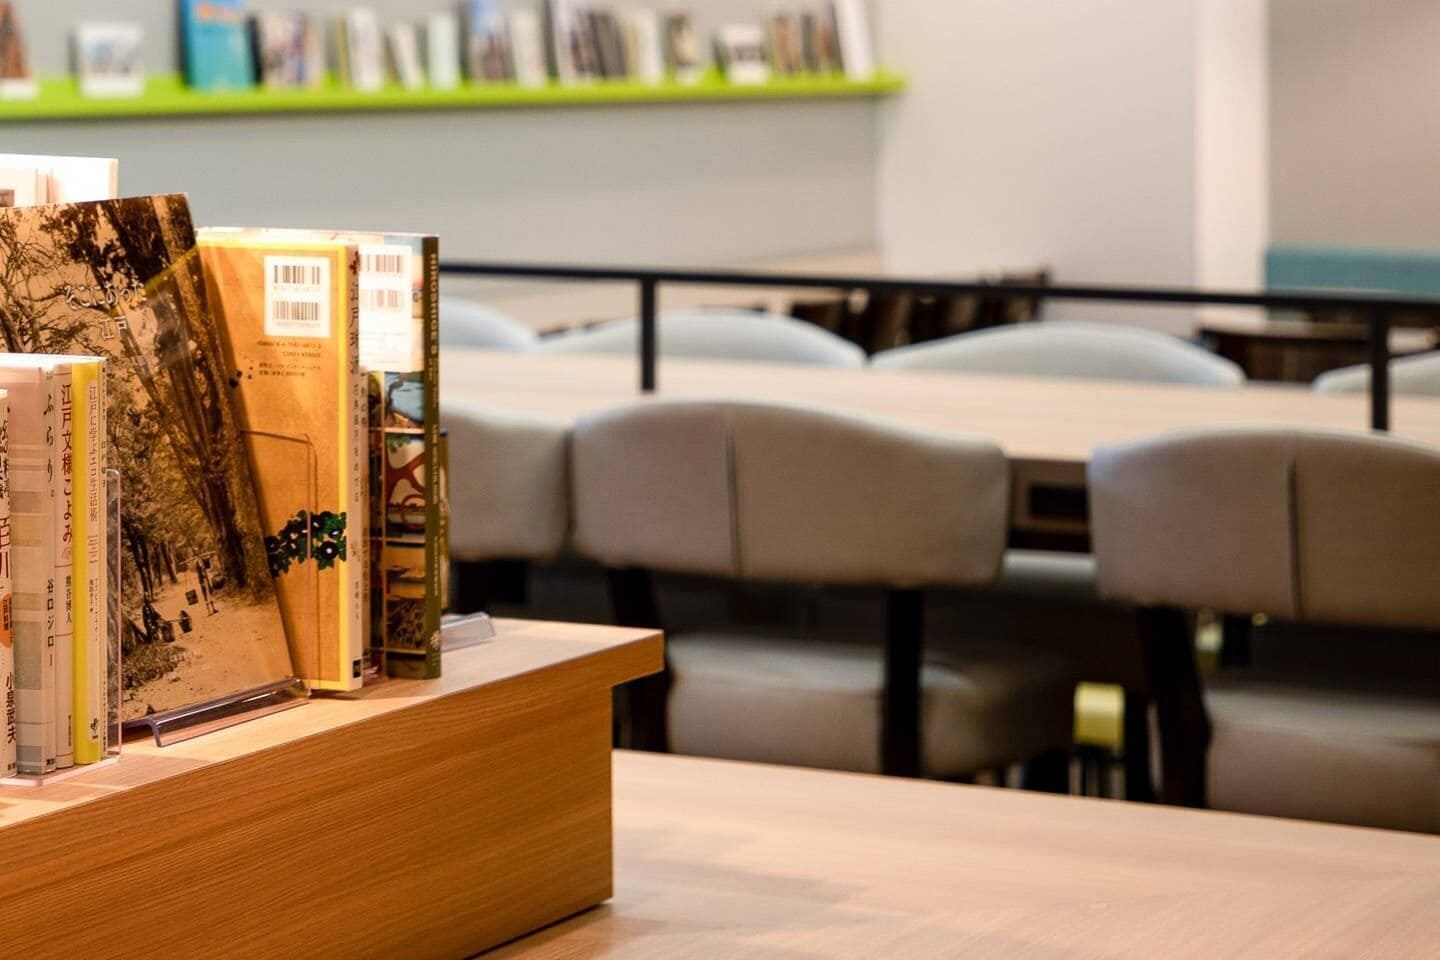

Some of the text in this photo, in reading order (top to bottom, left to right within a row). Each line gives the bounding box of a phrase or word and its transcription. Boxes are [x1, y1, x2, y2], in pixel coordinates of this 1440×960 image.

[99, 314, 128, 339] 江戸
[61, 383, 73, 544] 江戸文様こよみ
[46, 579, 55, 667] 谷口ジロー
